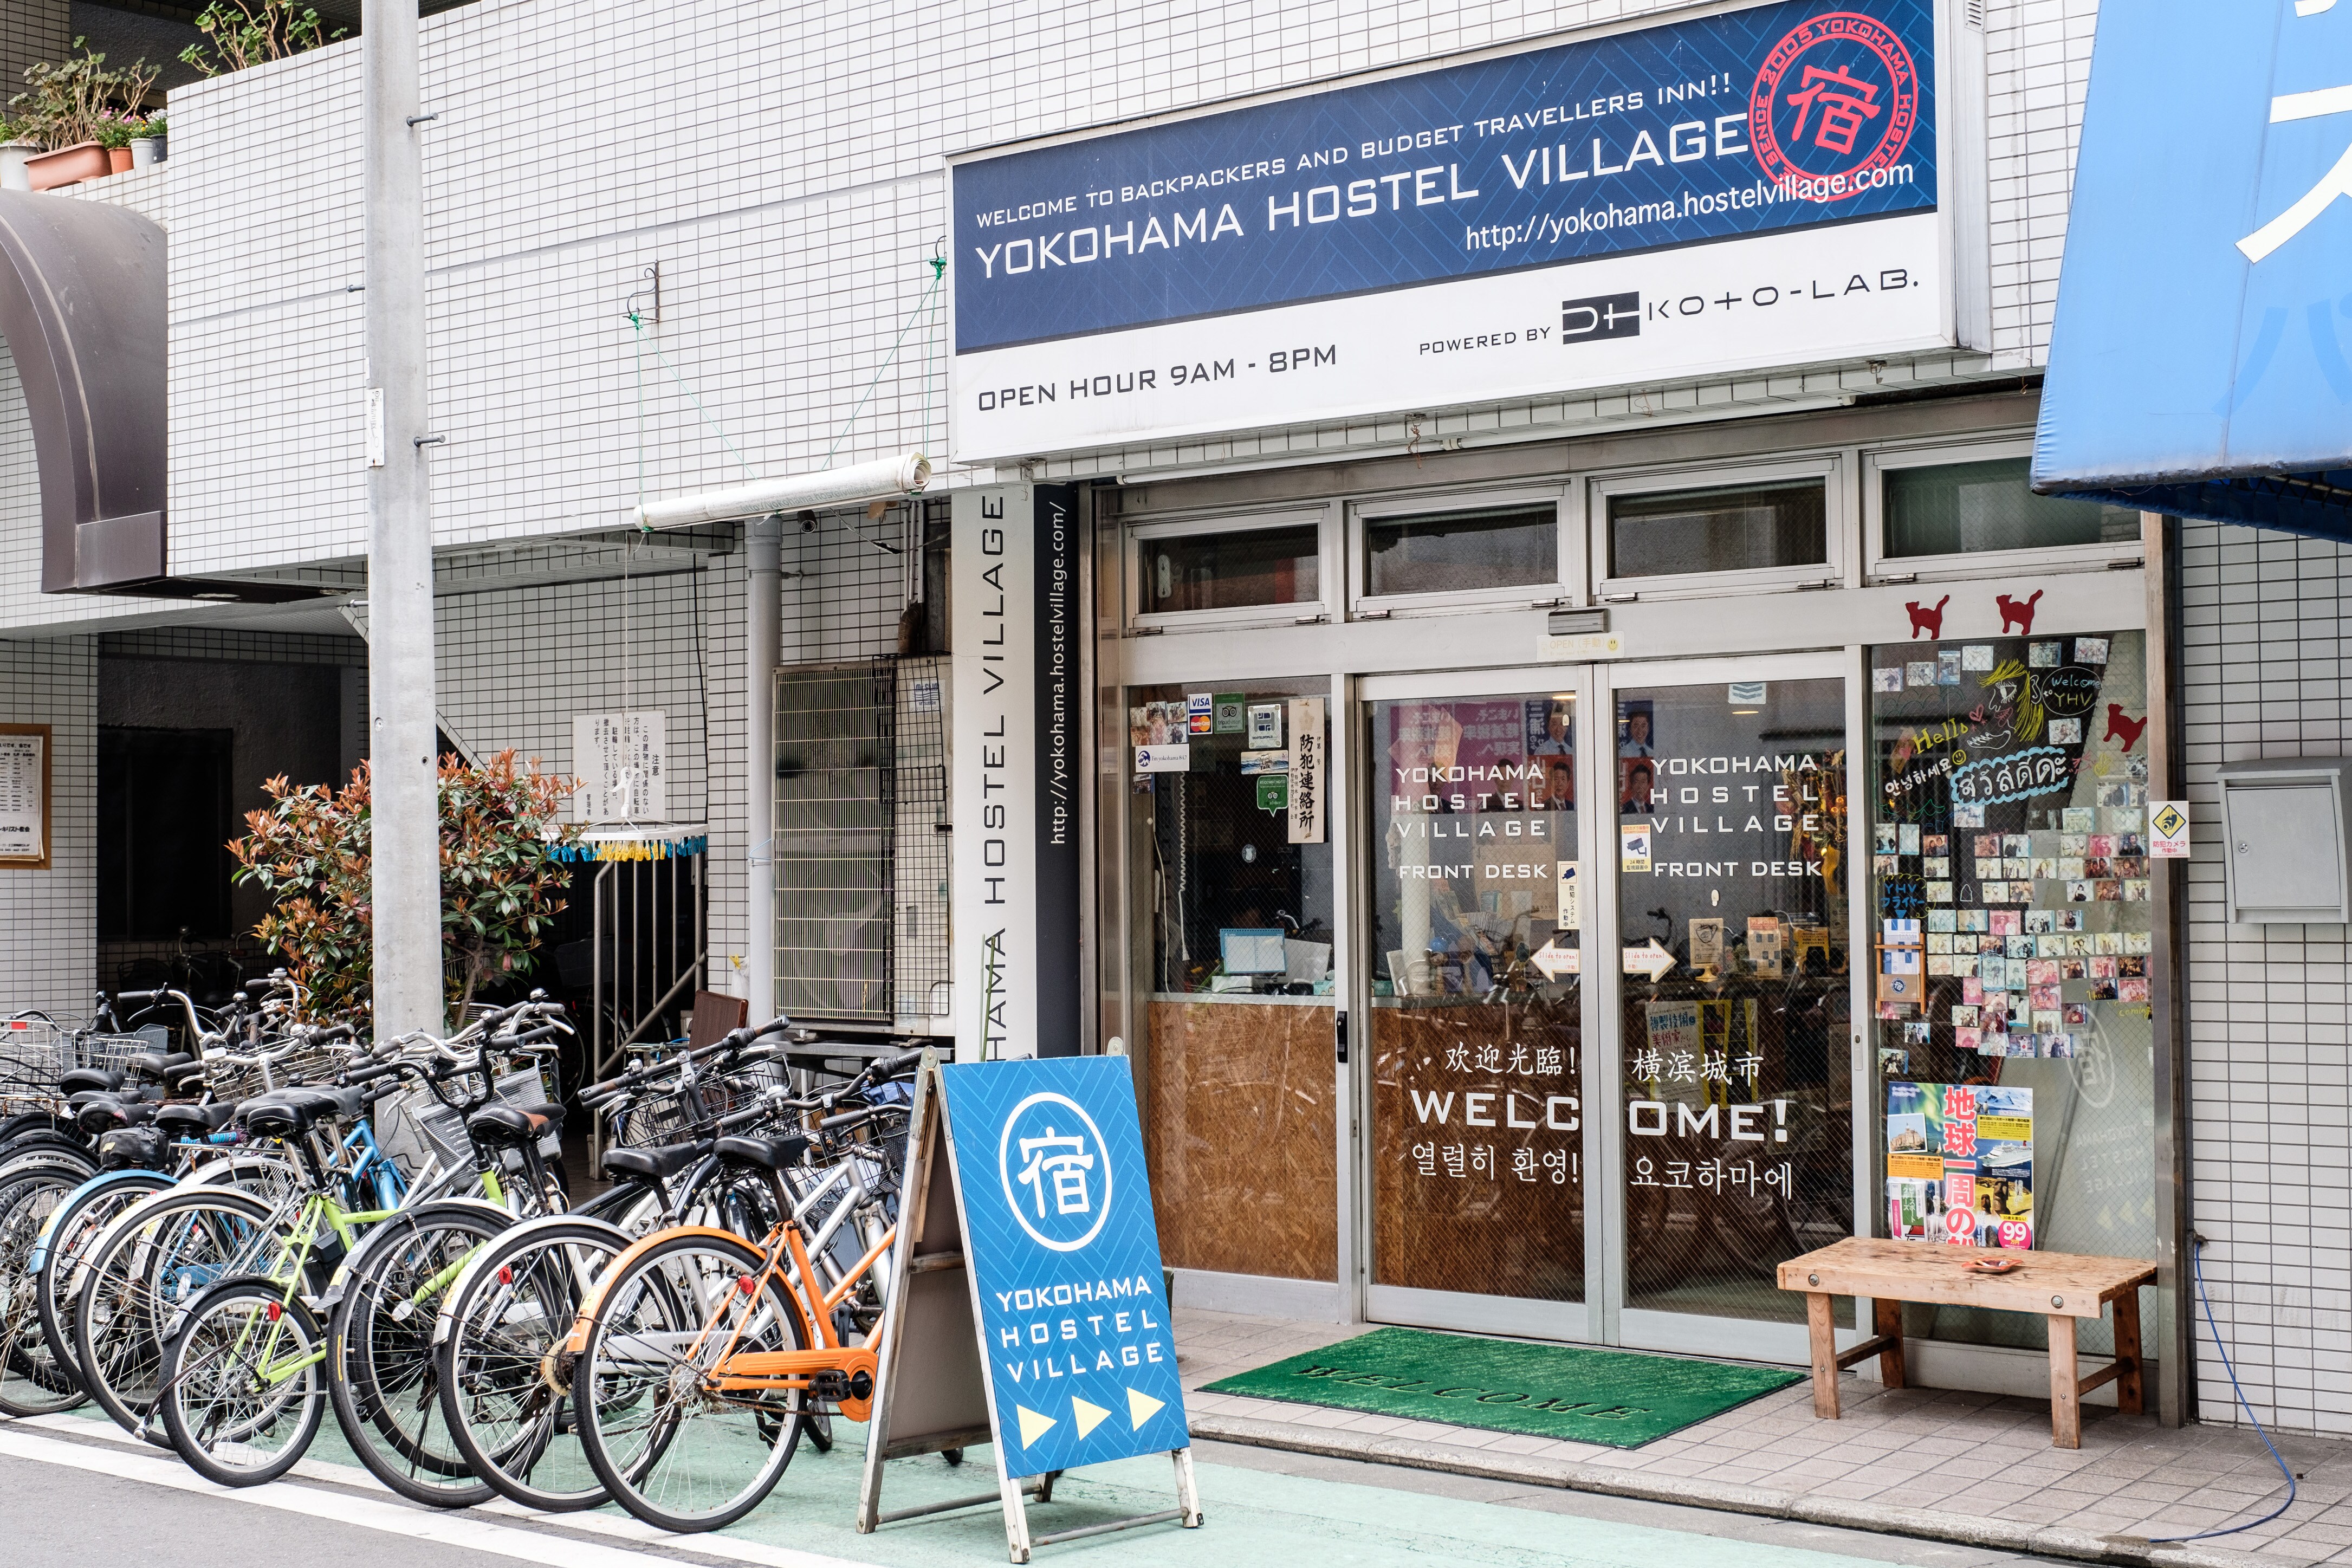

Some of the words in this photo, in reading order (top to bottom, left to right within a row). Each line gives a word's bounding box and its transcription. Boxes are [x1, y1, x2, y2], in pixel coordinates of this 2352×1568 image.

[1762, 27, 1813, 87] 2005
[1816, 20, 1909, 87] YOKOHAMA
[1787, 65, 1881, 154] 宿
[976, 196, 1077, 229] WELCOME
[1086, 189, 1113, 208] TO
[1122, 158, 1286, 203] BACKPACKERS
[1297, 146, 1349, 171] AND
[1362, 124, 1463, 159] BUDGET
[1474, 92, 1643, 139] TRAVELLERS
[1658, 73, 1731, 102] INN!!
[975, 203, 1245, 280] YOKOHAMA
[1269, 164, 1479, 231] HOSTEL
[1501, 113, 1749, 189] VILLAGE
[1466, 161, 1914, 251] http://yokohama.hostelvillage.com
[1419, 331, 1517, 355] POWERED
[1526, 326, 1551, 345] BY
[979, 383, 1056, 412] OPEN
[1070, 369, 1156, 400] HOUR
[1170, 358, 1235, 386] 9AM
[1270, 344, 1337, 373] 8PM
[982, 496, 1004, 695] VILLAGE
[1049, 501, 1068, 844] http://yokohama.hostelvillage.com/
[2051, 675, 2101, 689] Welcome
[1193, 698, 1210, 707] VISA
[2054, 692, 2093, 708] YHV
[1912, 718, 1968, 755] Hello
[652, 754, 659, 776] 注意
[1299, 734, 1316, 832] 防犯連絡所
[1396, 764, 1544, 783] YOKOHAMA
[1651, 755, 1818, 776] YOKOHAMA
[1885, 758, 1952, 797] 안녕하세요
[983, 715, 1006, 904] HOSTEL
[1396, 792, 1544, 811] HOSTEL
[1650, 785, 1819, 805] HOSTEL
[1397, 819, 1545, 838] VILLAGE
[1651, 814, 1819, 834] VILLAGE
[1399, 865, 1474, 879] FRONT
[1486, 864, 1548, 879] DESK
[1655, 863, 1734, 878] FRONT
[1752, 861, 1823, 877] DESK
[1885, 883, 1917, 895] YHV
[1018, 1126, 1093, 1219] 宿
[1411, 1141, 1495, 1182] 열렬히
[1512, 1146, 1578, 1185] 환영!
[1630, 1156, 1793, 1201] 요코하마에
[2003, 1222, 2027, 1241] 99
[996, 1277, 1151, 1312] YOKOHAMA
[1001, 1310, 1158, 1348] HOSTEL
[1007, 1342, 1163, 1383] VILLAGE
[1291, 1364, 1654, 1421] WELCOME
